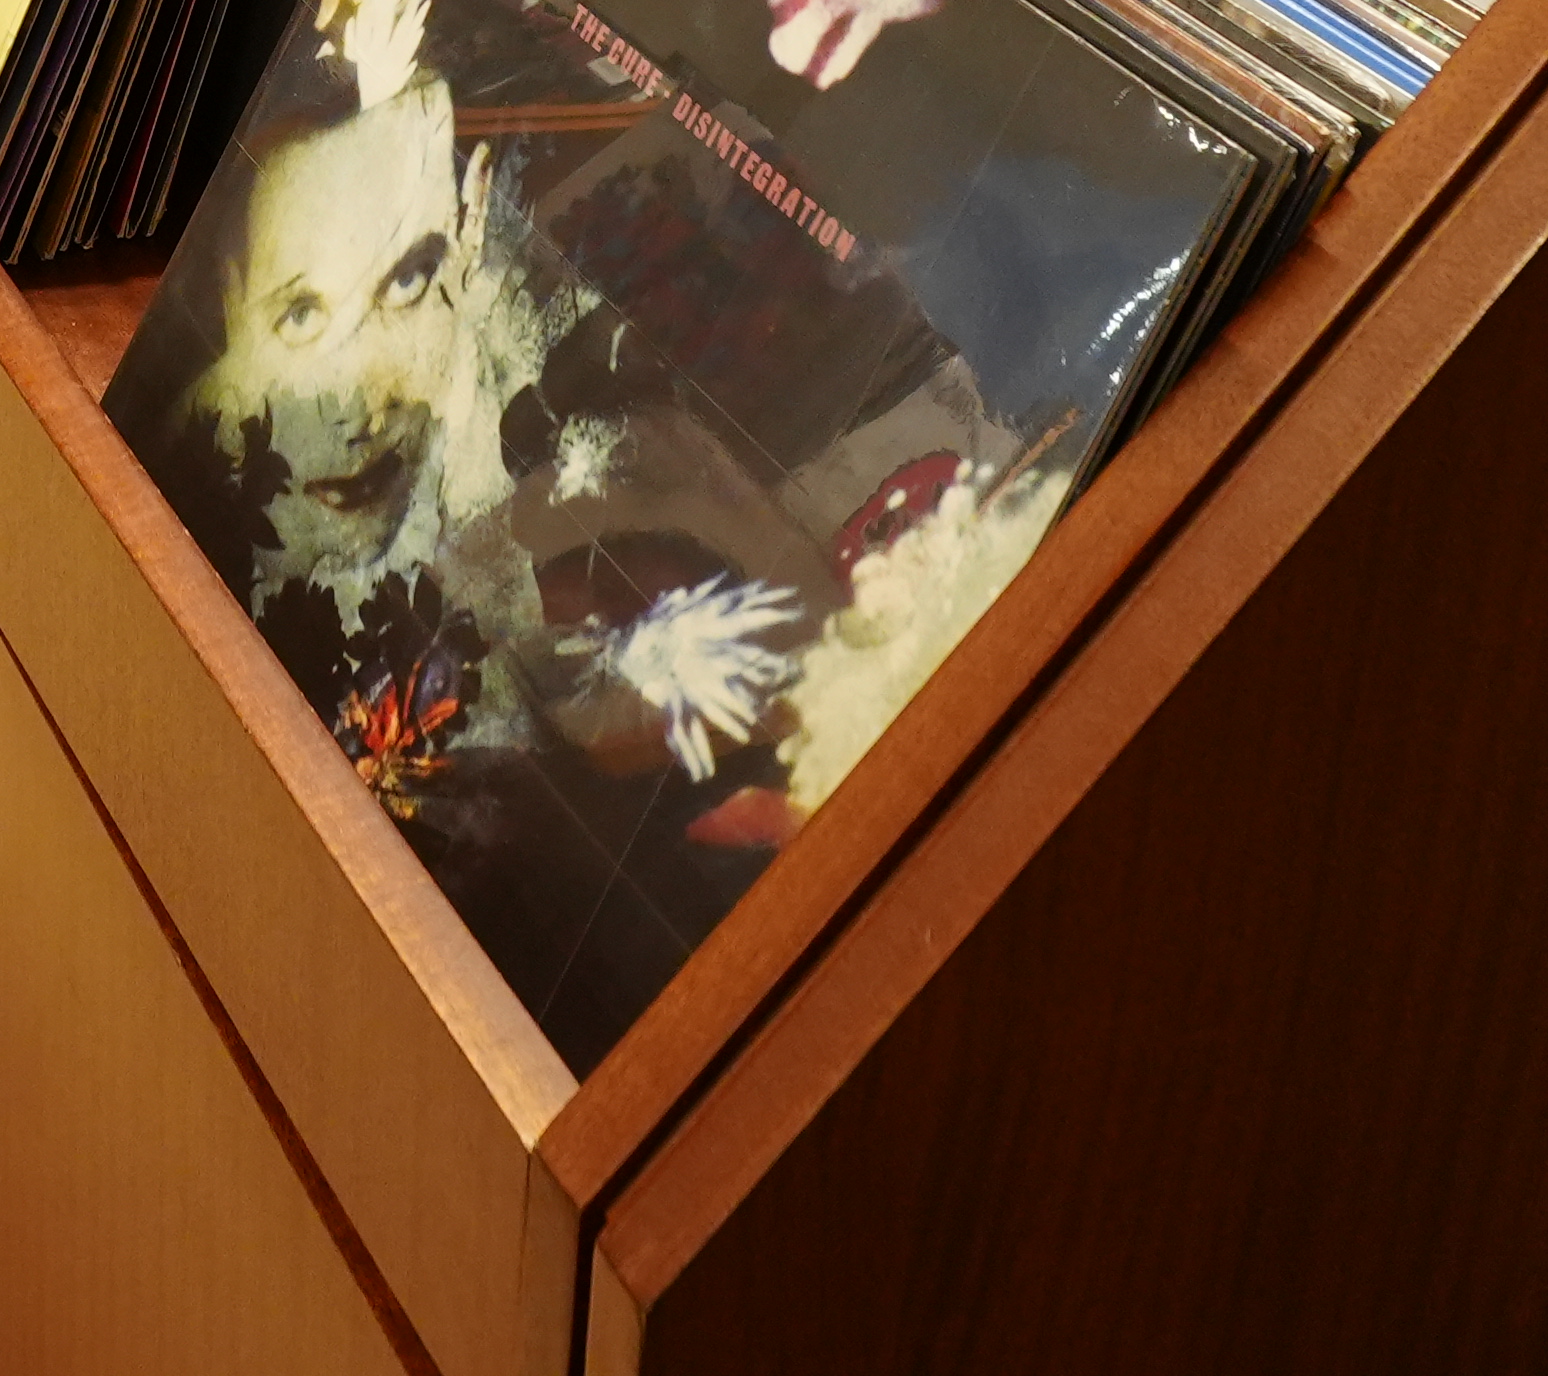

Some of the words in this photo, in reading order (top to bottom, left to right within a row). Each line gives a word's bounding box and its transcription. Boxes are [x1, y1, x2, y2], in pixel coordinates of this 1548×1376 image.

[570, 2, 611, 54] THE
[608, 37, 664, 98] CURE
[672, 92, 857, 262] DISINTEGRATION
